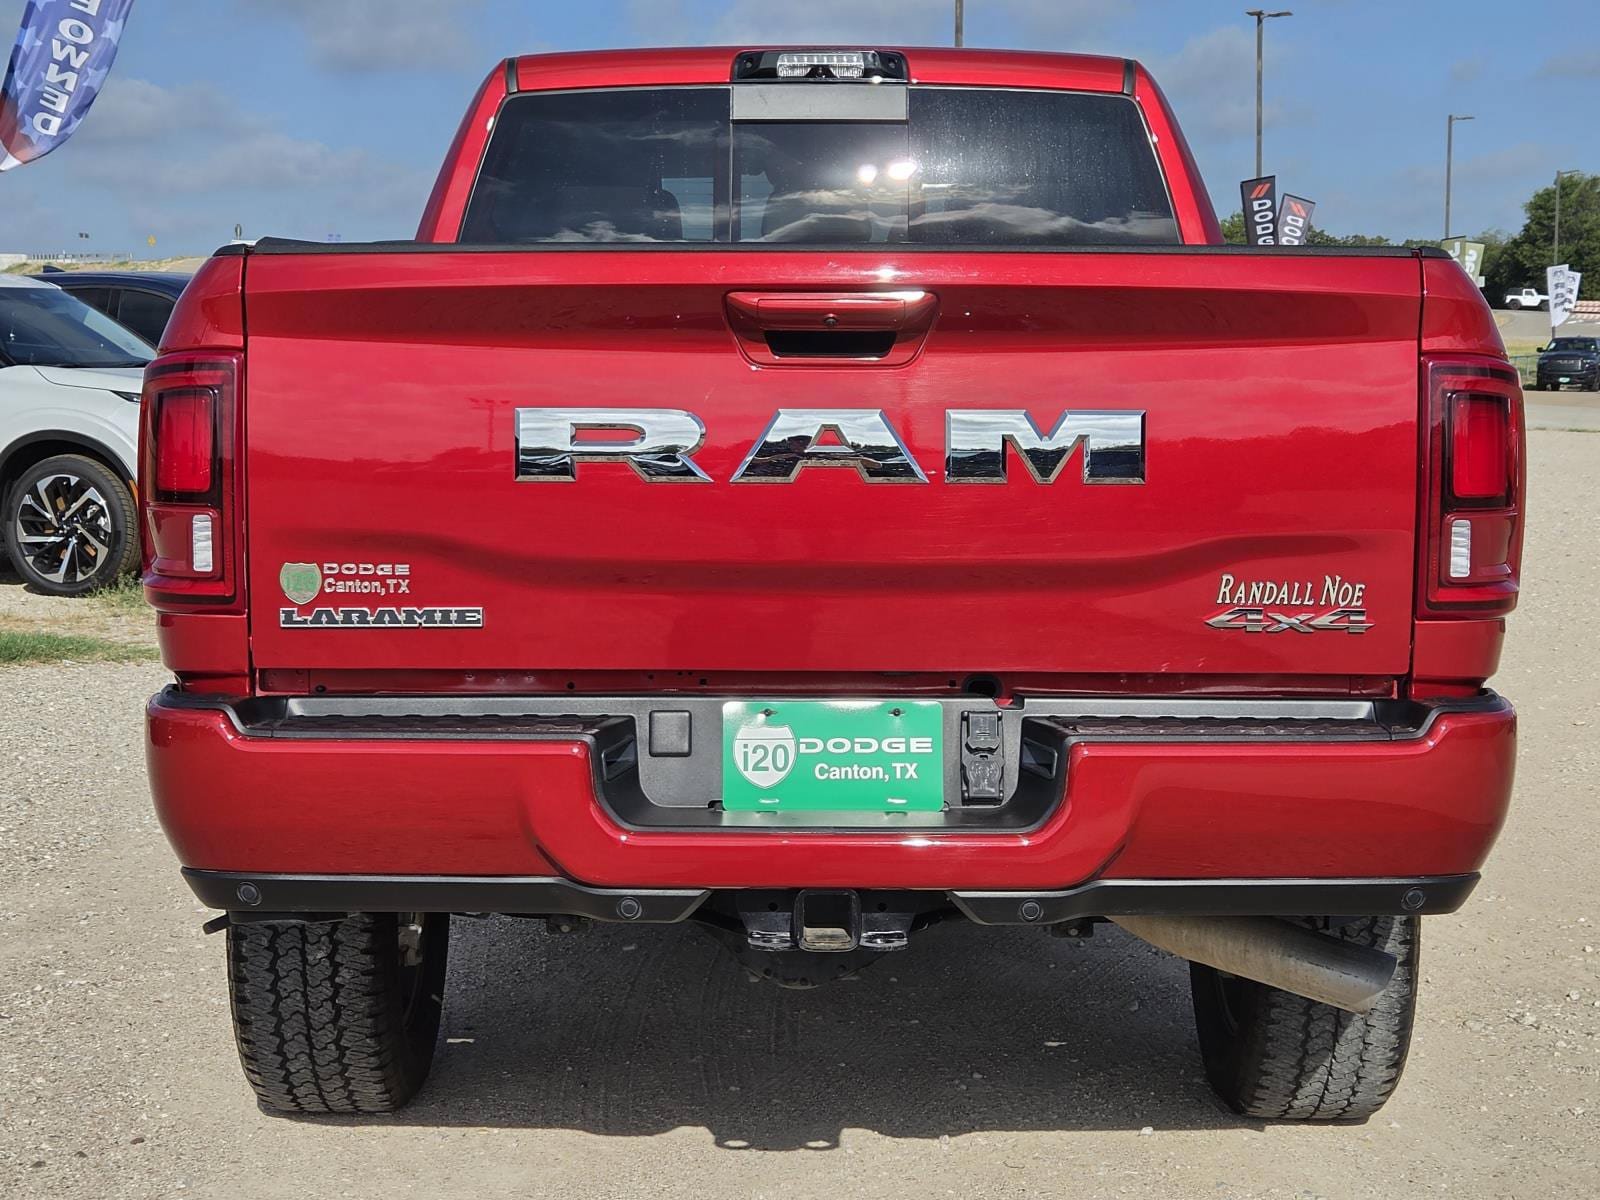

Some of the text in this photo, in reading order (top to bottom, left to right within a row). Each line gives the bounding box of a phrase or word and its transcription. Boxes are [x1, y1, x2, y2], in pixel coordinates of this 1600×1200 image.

[514, 407, 1146, 485] RAM
[323, 563, 410, 575] DODGE
[1216, 573, 1366, 607] RANDALL NOE
[279, 607, 484, 629] LARAMIE
[742, 743, 790, 772] i20
[799, 737, 933, 753] DODGE
